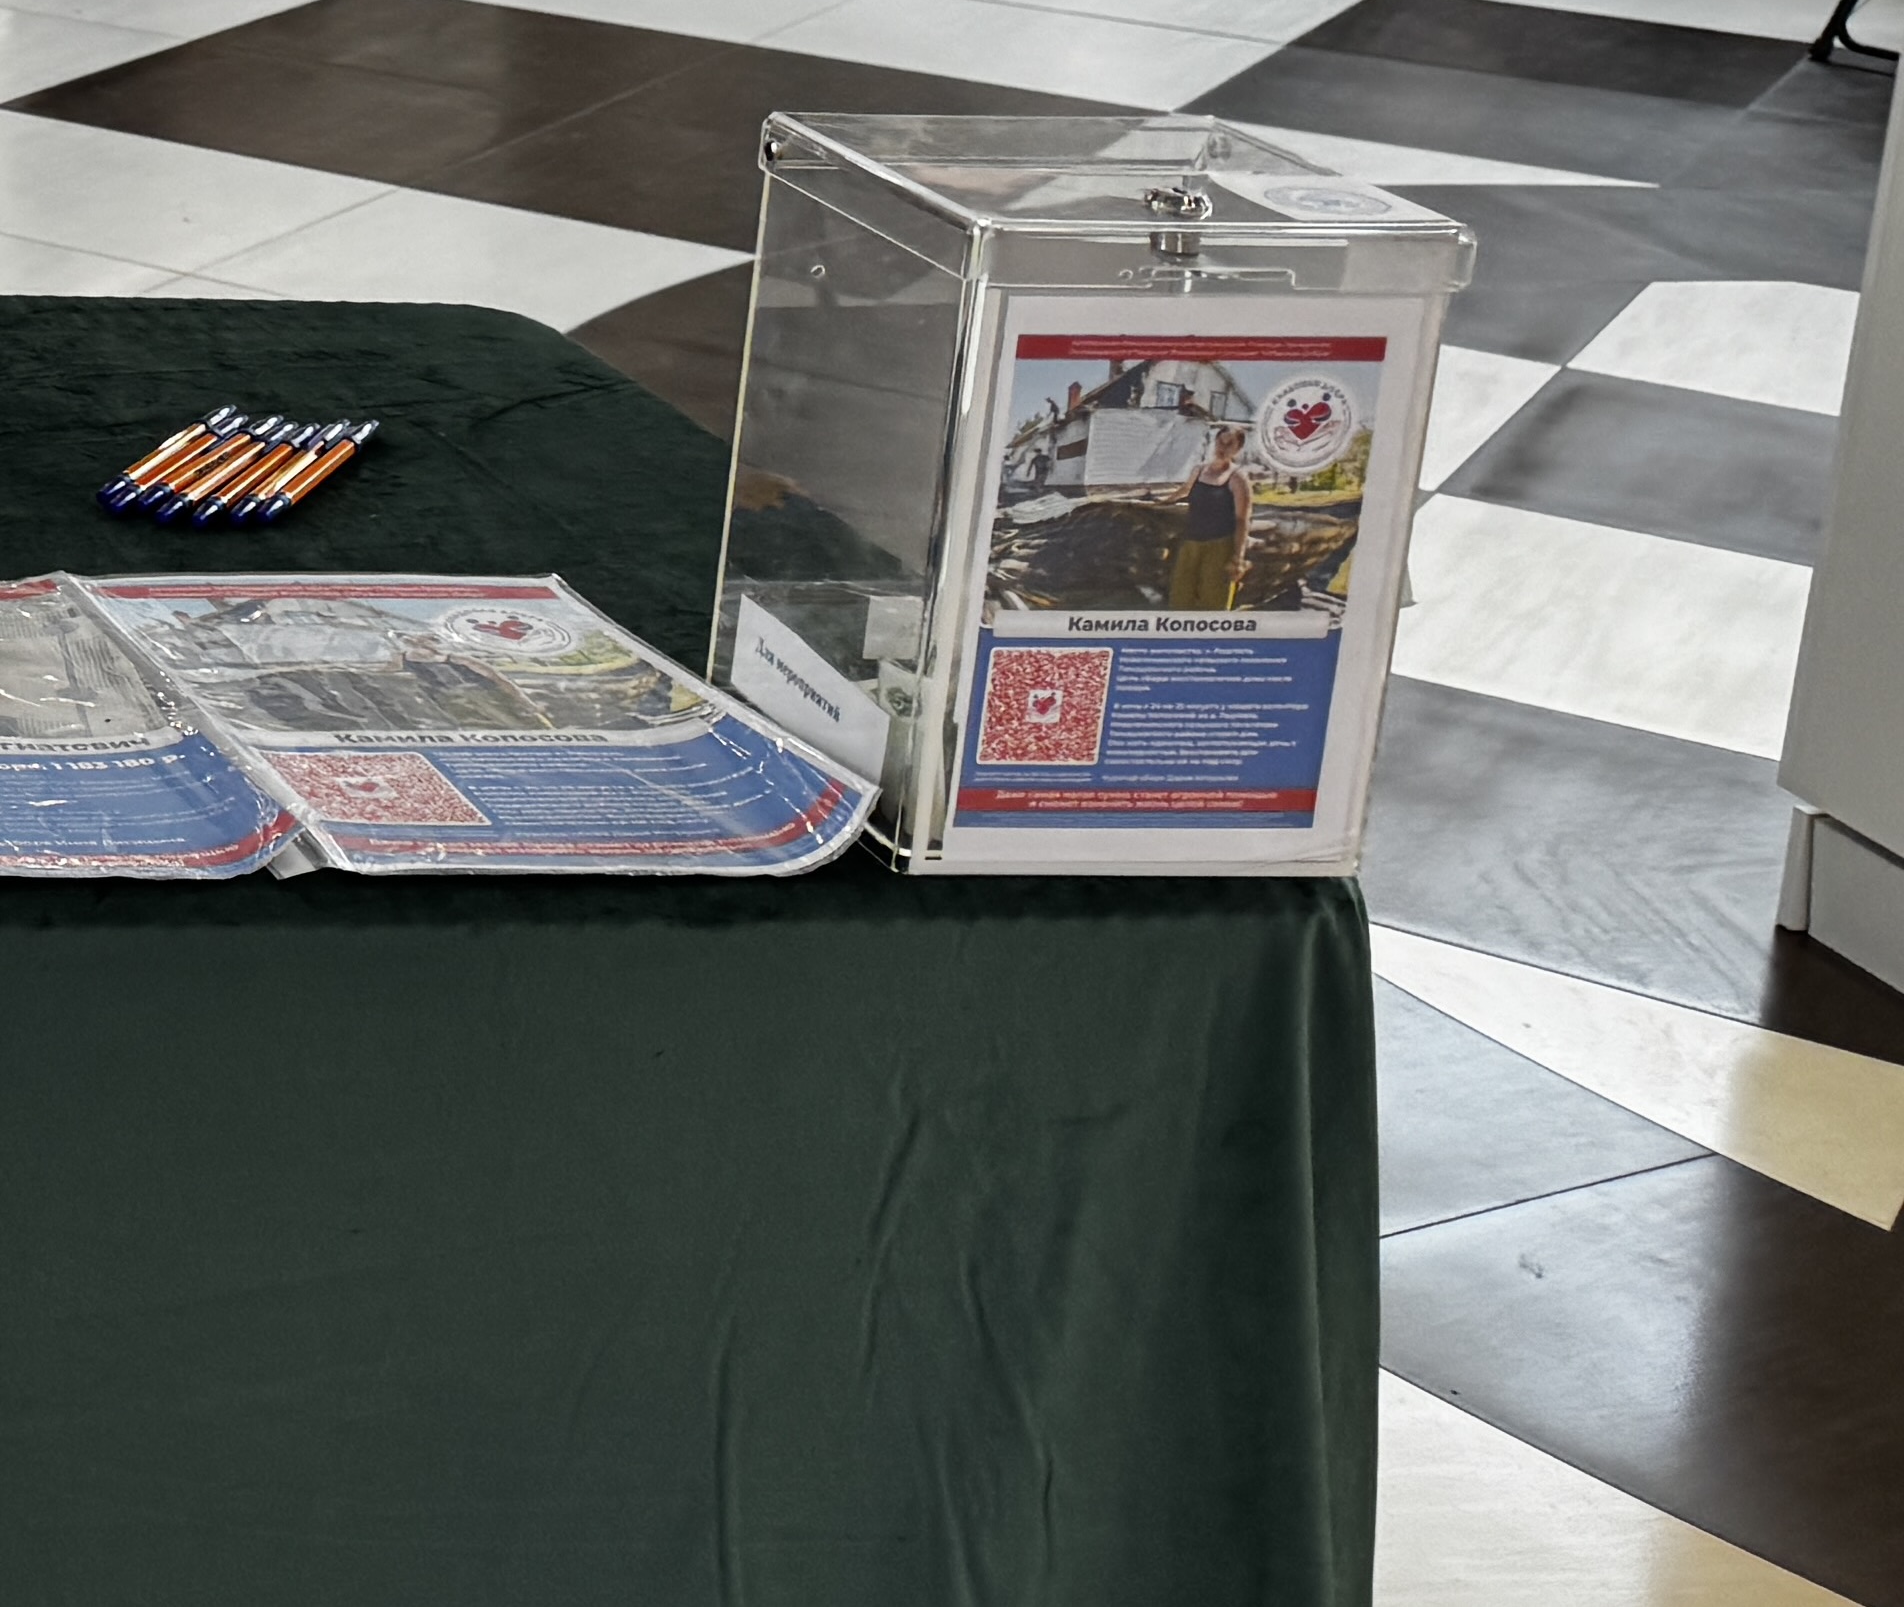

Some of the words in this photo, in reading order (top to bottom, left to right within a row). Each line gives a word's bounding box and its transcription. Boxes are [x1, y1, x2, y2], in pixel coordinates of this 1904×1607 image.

[1067, 616, 1149, 632] Камила
[1155, 616, 1257, 632] Копосова
[334, 734, 454, 745] Камила
